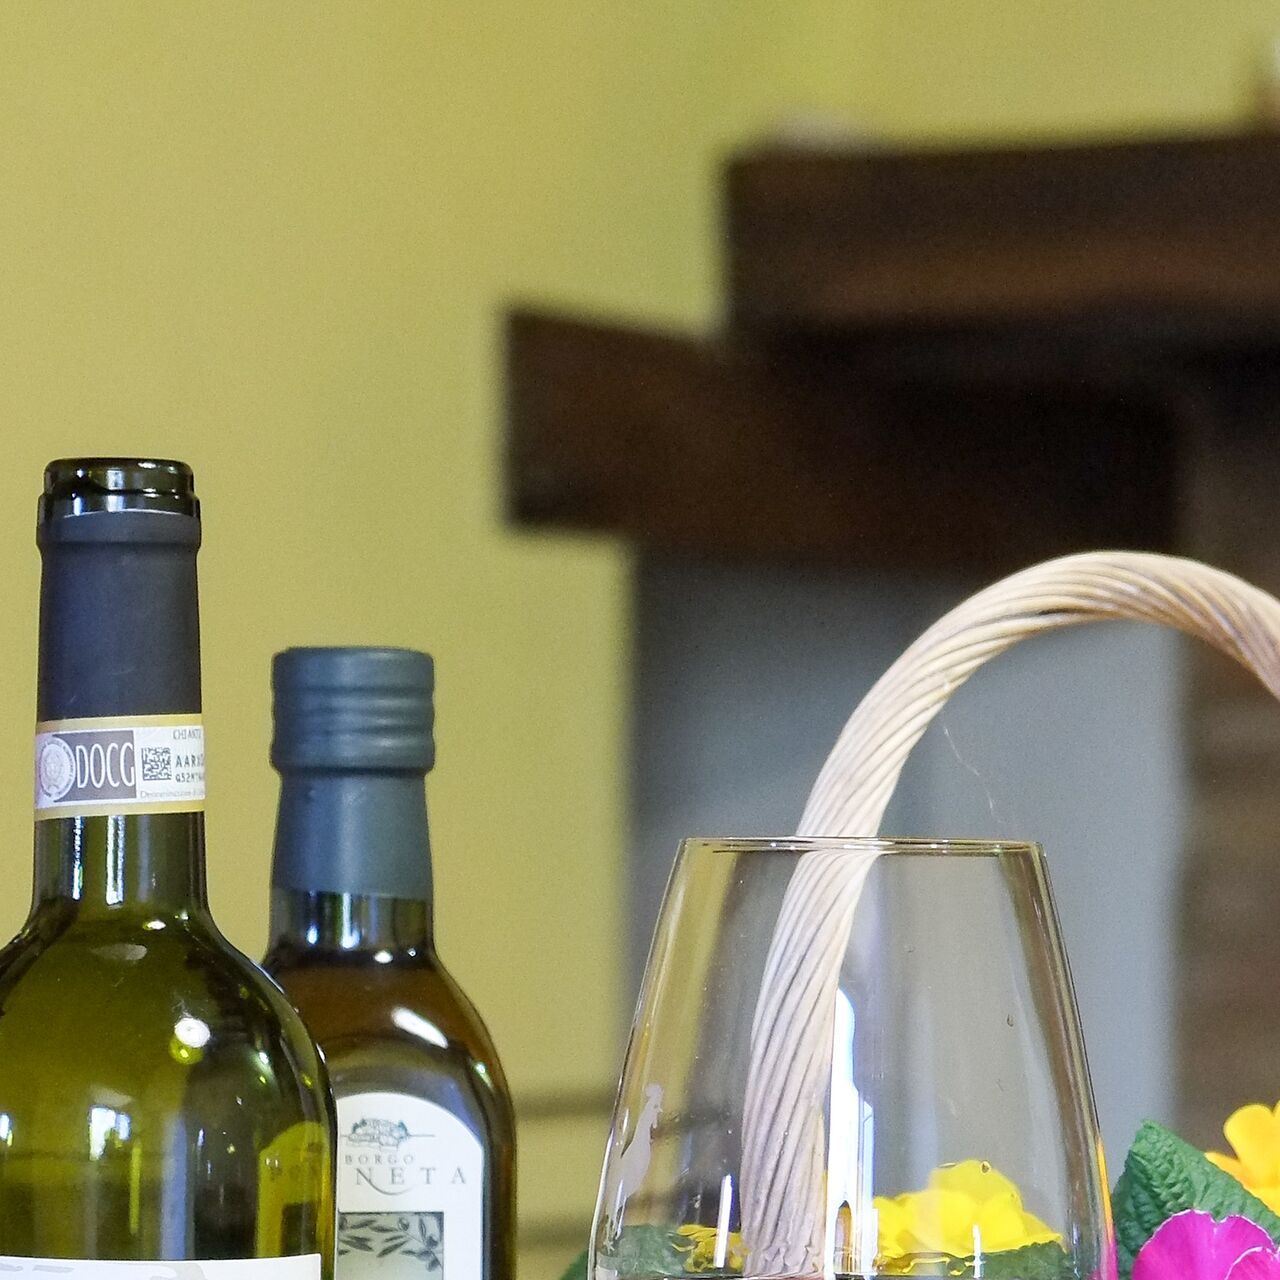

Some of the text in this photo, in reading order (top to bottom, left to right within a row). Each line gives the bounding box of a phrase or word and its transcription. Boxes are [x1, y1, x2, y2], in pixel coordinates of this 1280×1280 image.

[75, 742, 135, 789] DOCG
[345, 1154, 414, 1165] BORGO
[356, 1166, 467, 1195] NETA
